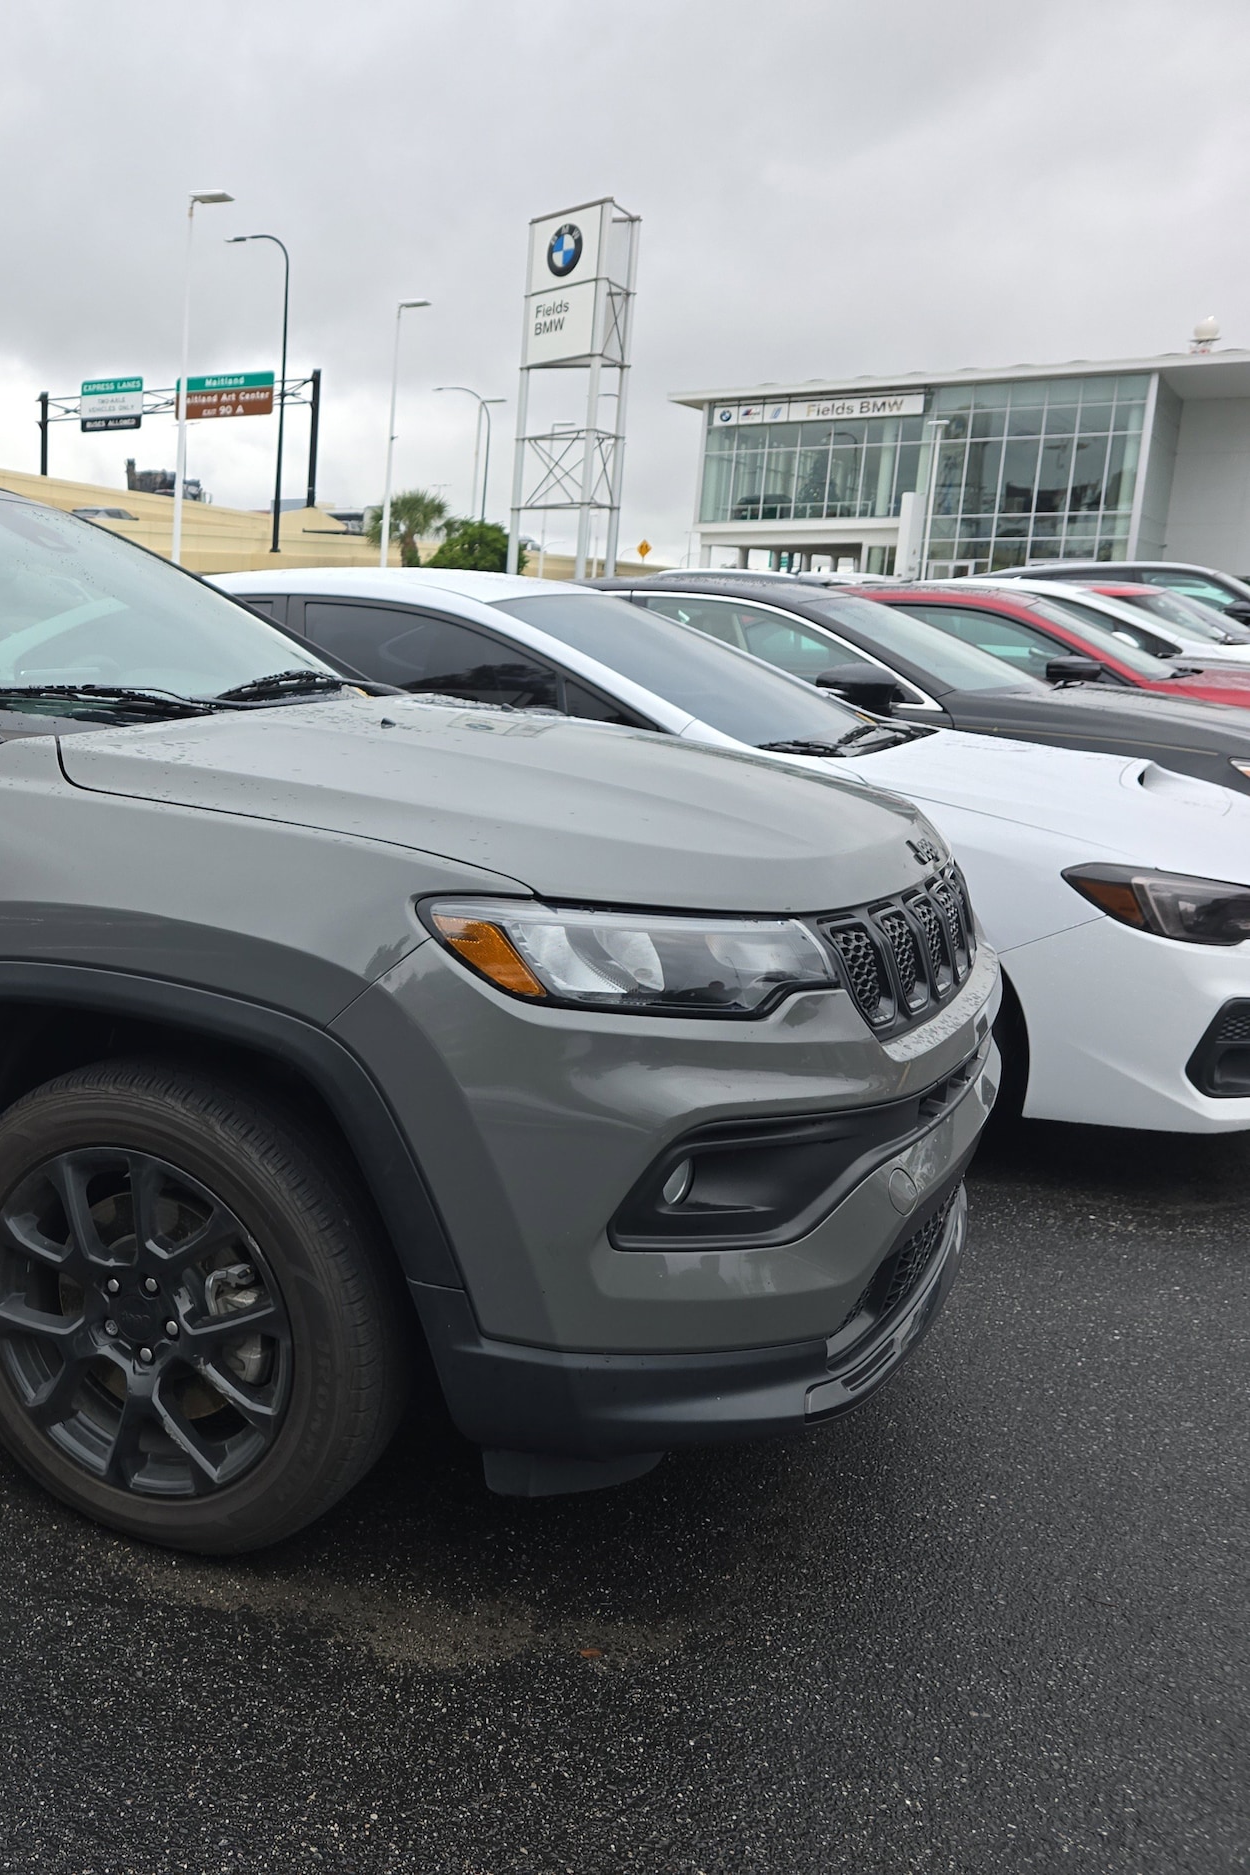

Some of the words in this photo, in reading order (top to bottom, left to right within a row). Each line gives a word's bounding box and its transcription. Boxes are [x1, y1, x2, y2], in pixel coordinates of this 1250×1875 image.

[535, 300, 569, 318] Fields
[534, 317, 565, 336] BMW
[83, 382, 115, 392] EXPRESS
[117, 380, 141, 389] LANES
[205, 376, 245, 387] Maitland
[221, 392, 236, 402] Art
[239, 391, 270, 401] Center
[219, 404, 233, 415] 90
[235, 404, 245, 414] A
[806, 402, 854, 417] Fields
[860, 399, 904, 414] BMW
